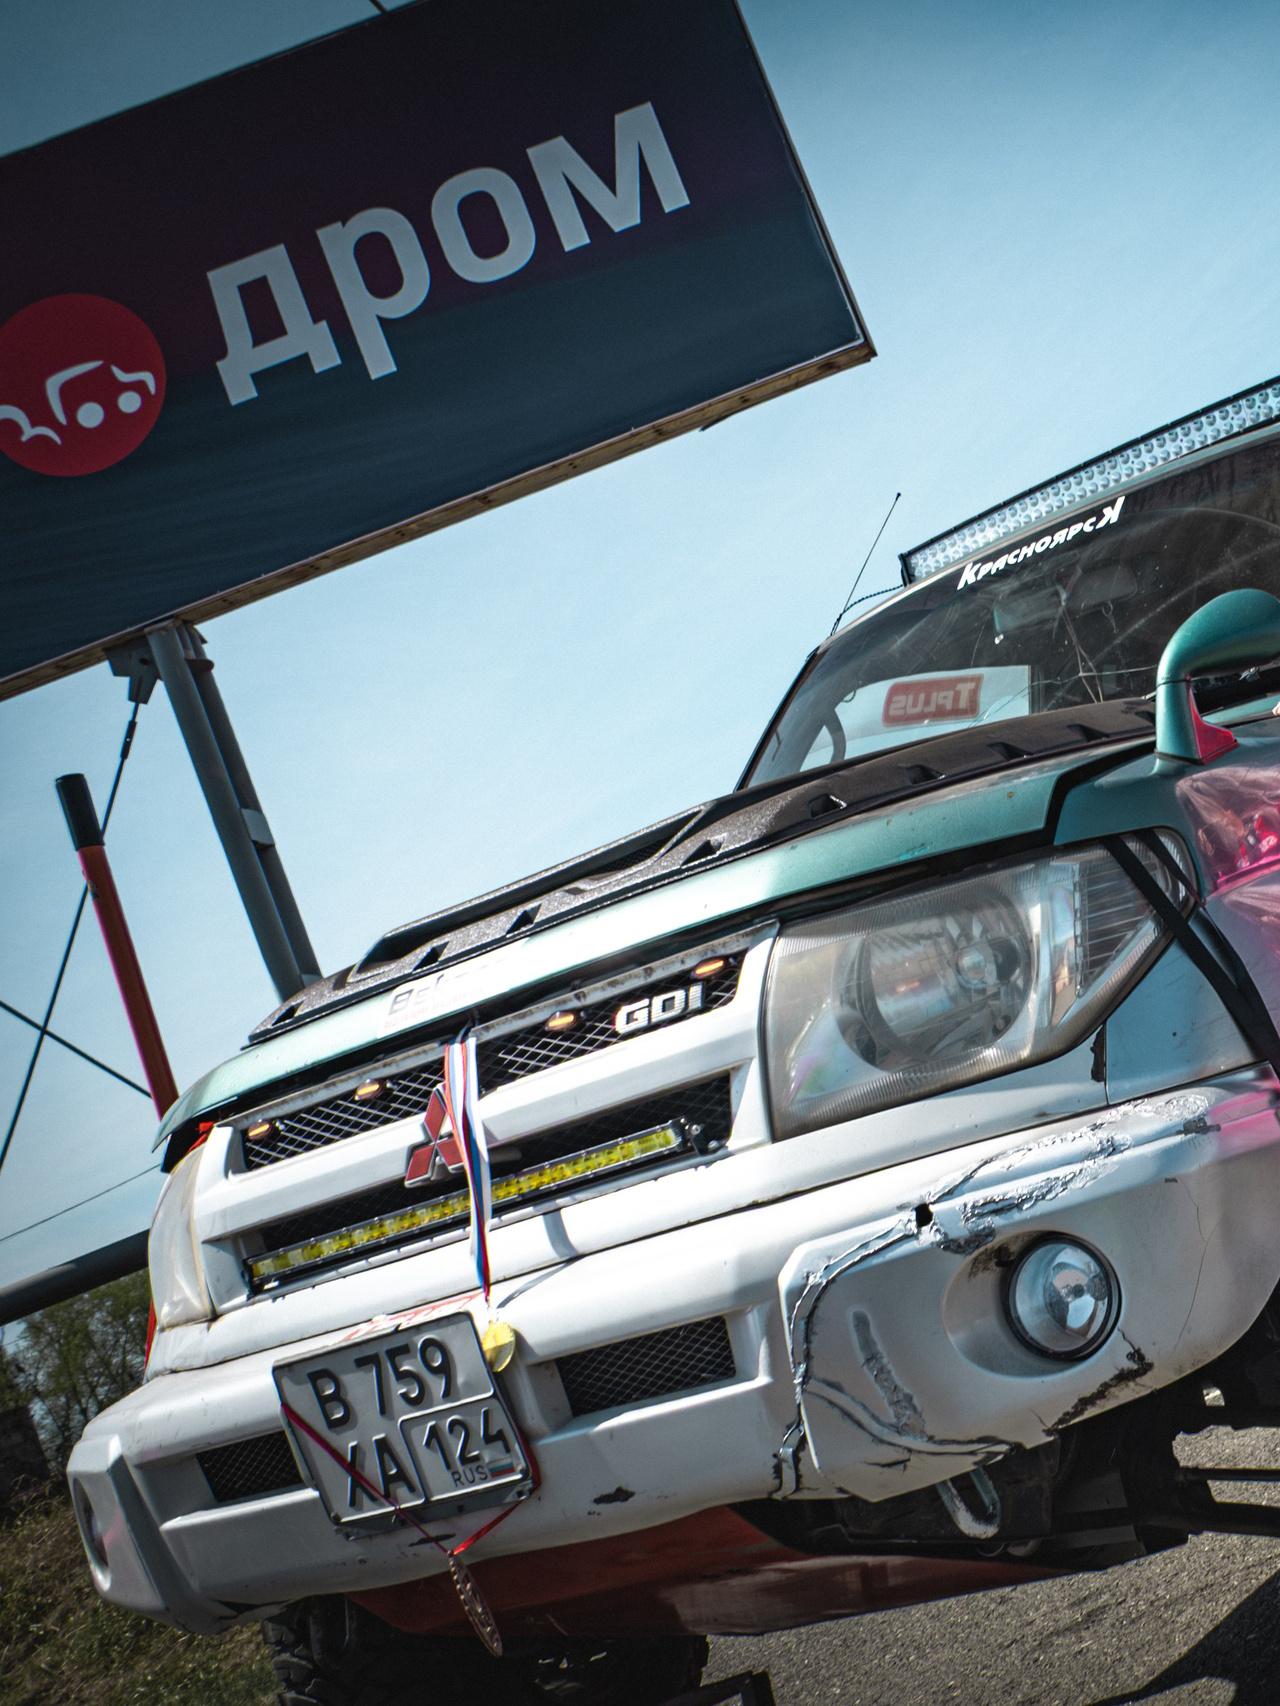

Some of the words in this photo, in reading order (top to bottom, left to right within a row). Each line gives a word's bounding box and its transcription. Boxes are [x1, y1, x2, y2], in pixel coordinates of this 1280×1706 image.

[614, 981, 706, 1035] GDI
[354, 1337, 451, 1416] 759
[423, 1407, 510, 1471] 124
[451, 1464, 489, 1488] RUS
